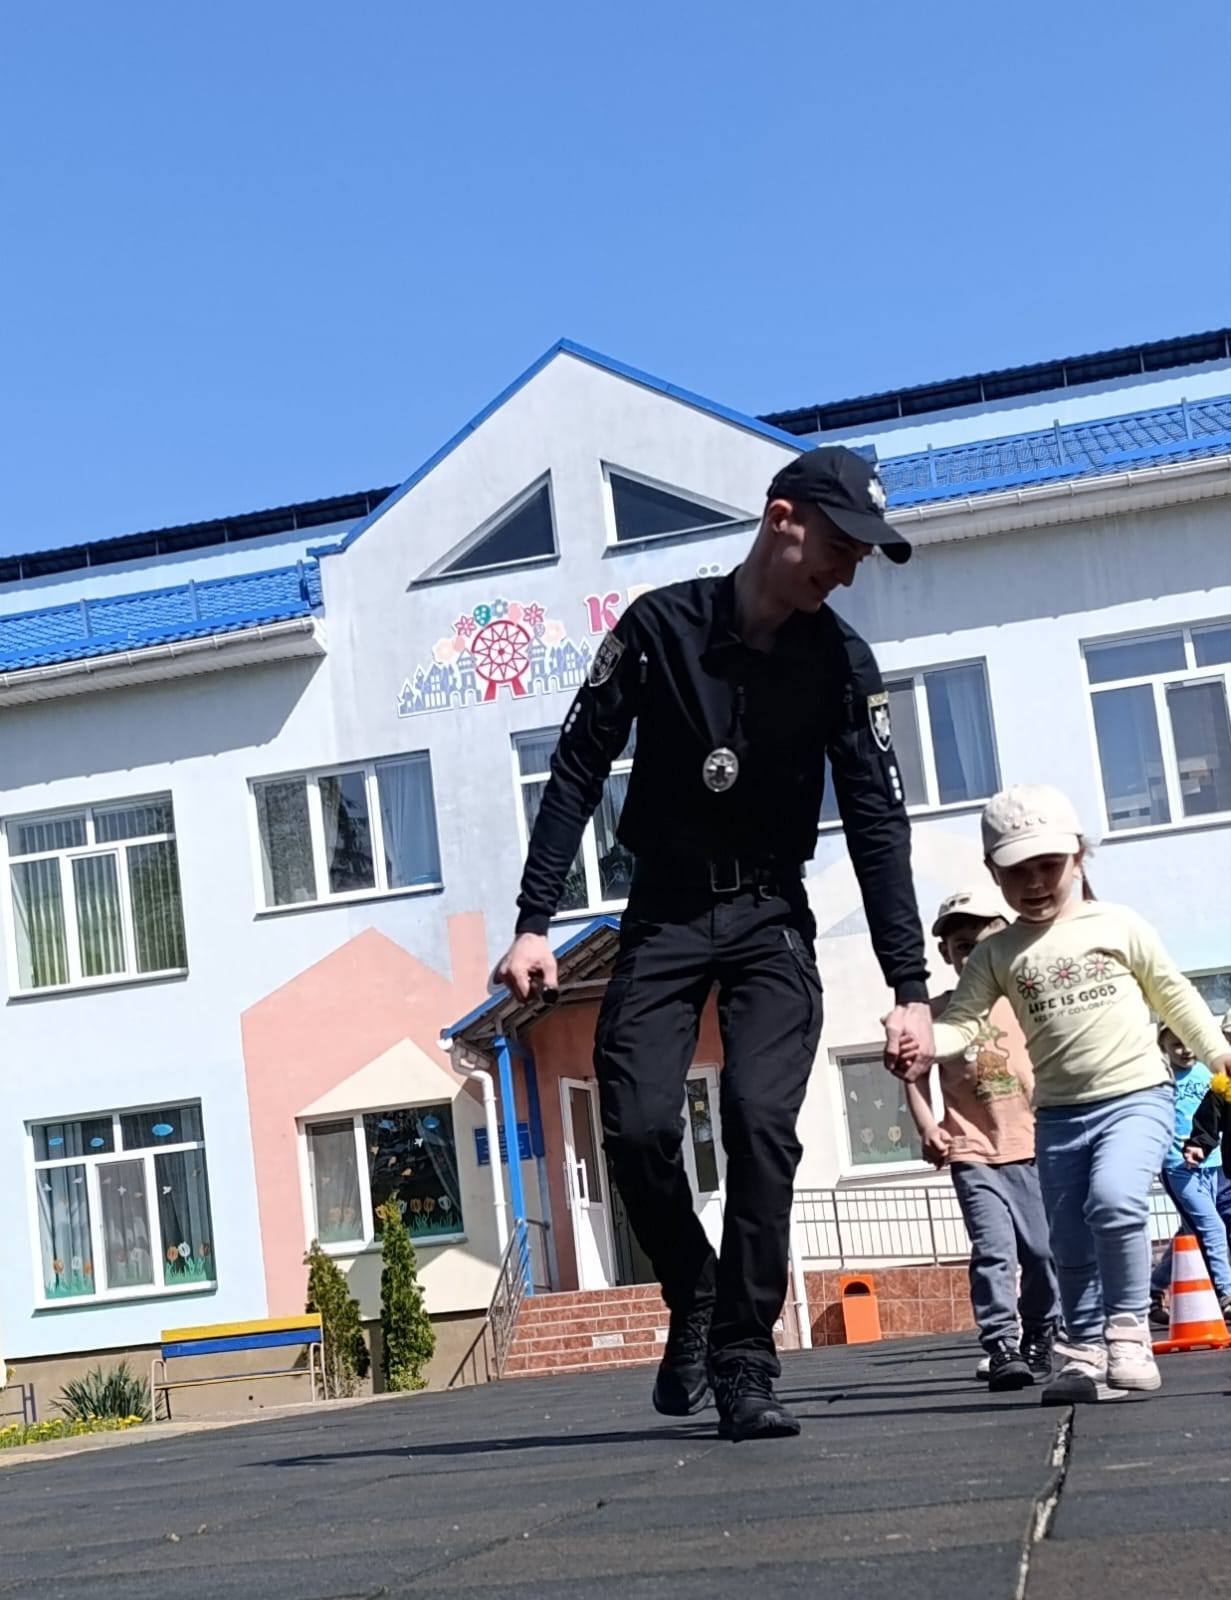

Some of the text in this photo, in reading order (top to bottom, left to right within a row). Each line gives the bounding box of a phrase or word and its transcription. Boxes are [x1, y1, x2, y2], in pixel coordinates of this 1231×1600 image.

[1028, 985, 1117, 1014] LIFE IS GOOD
